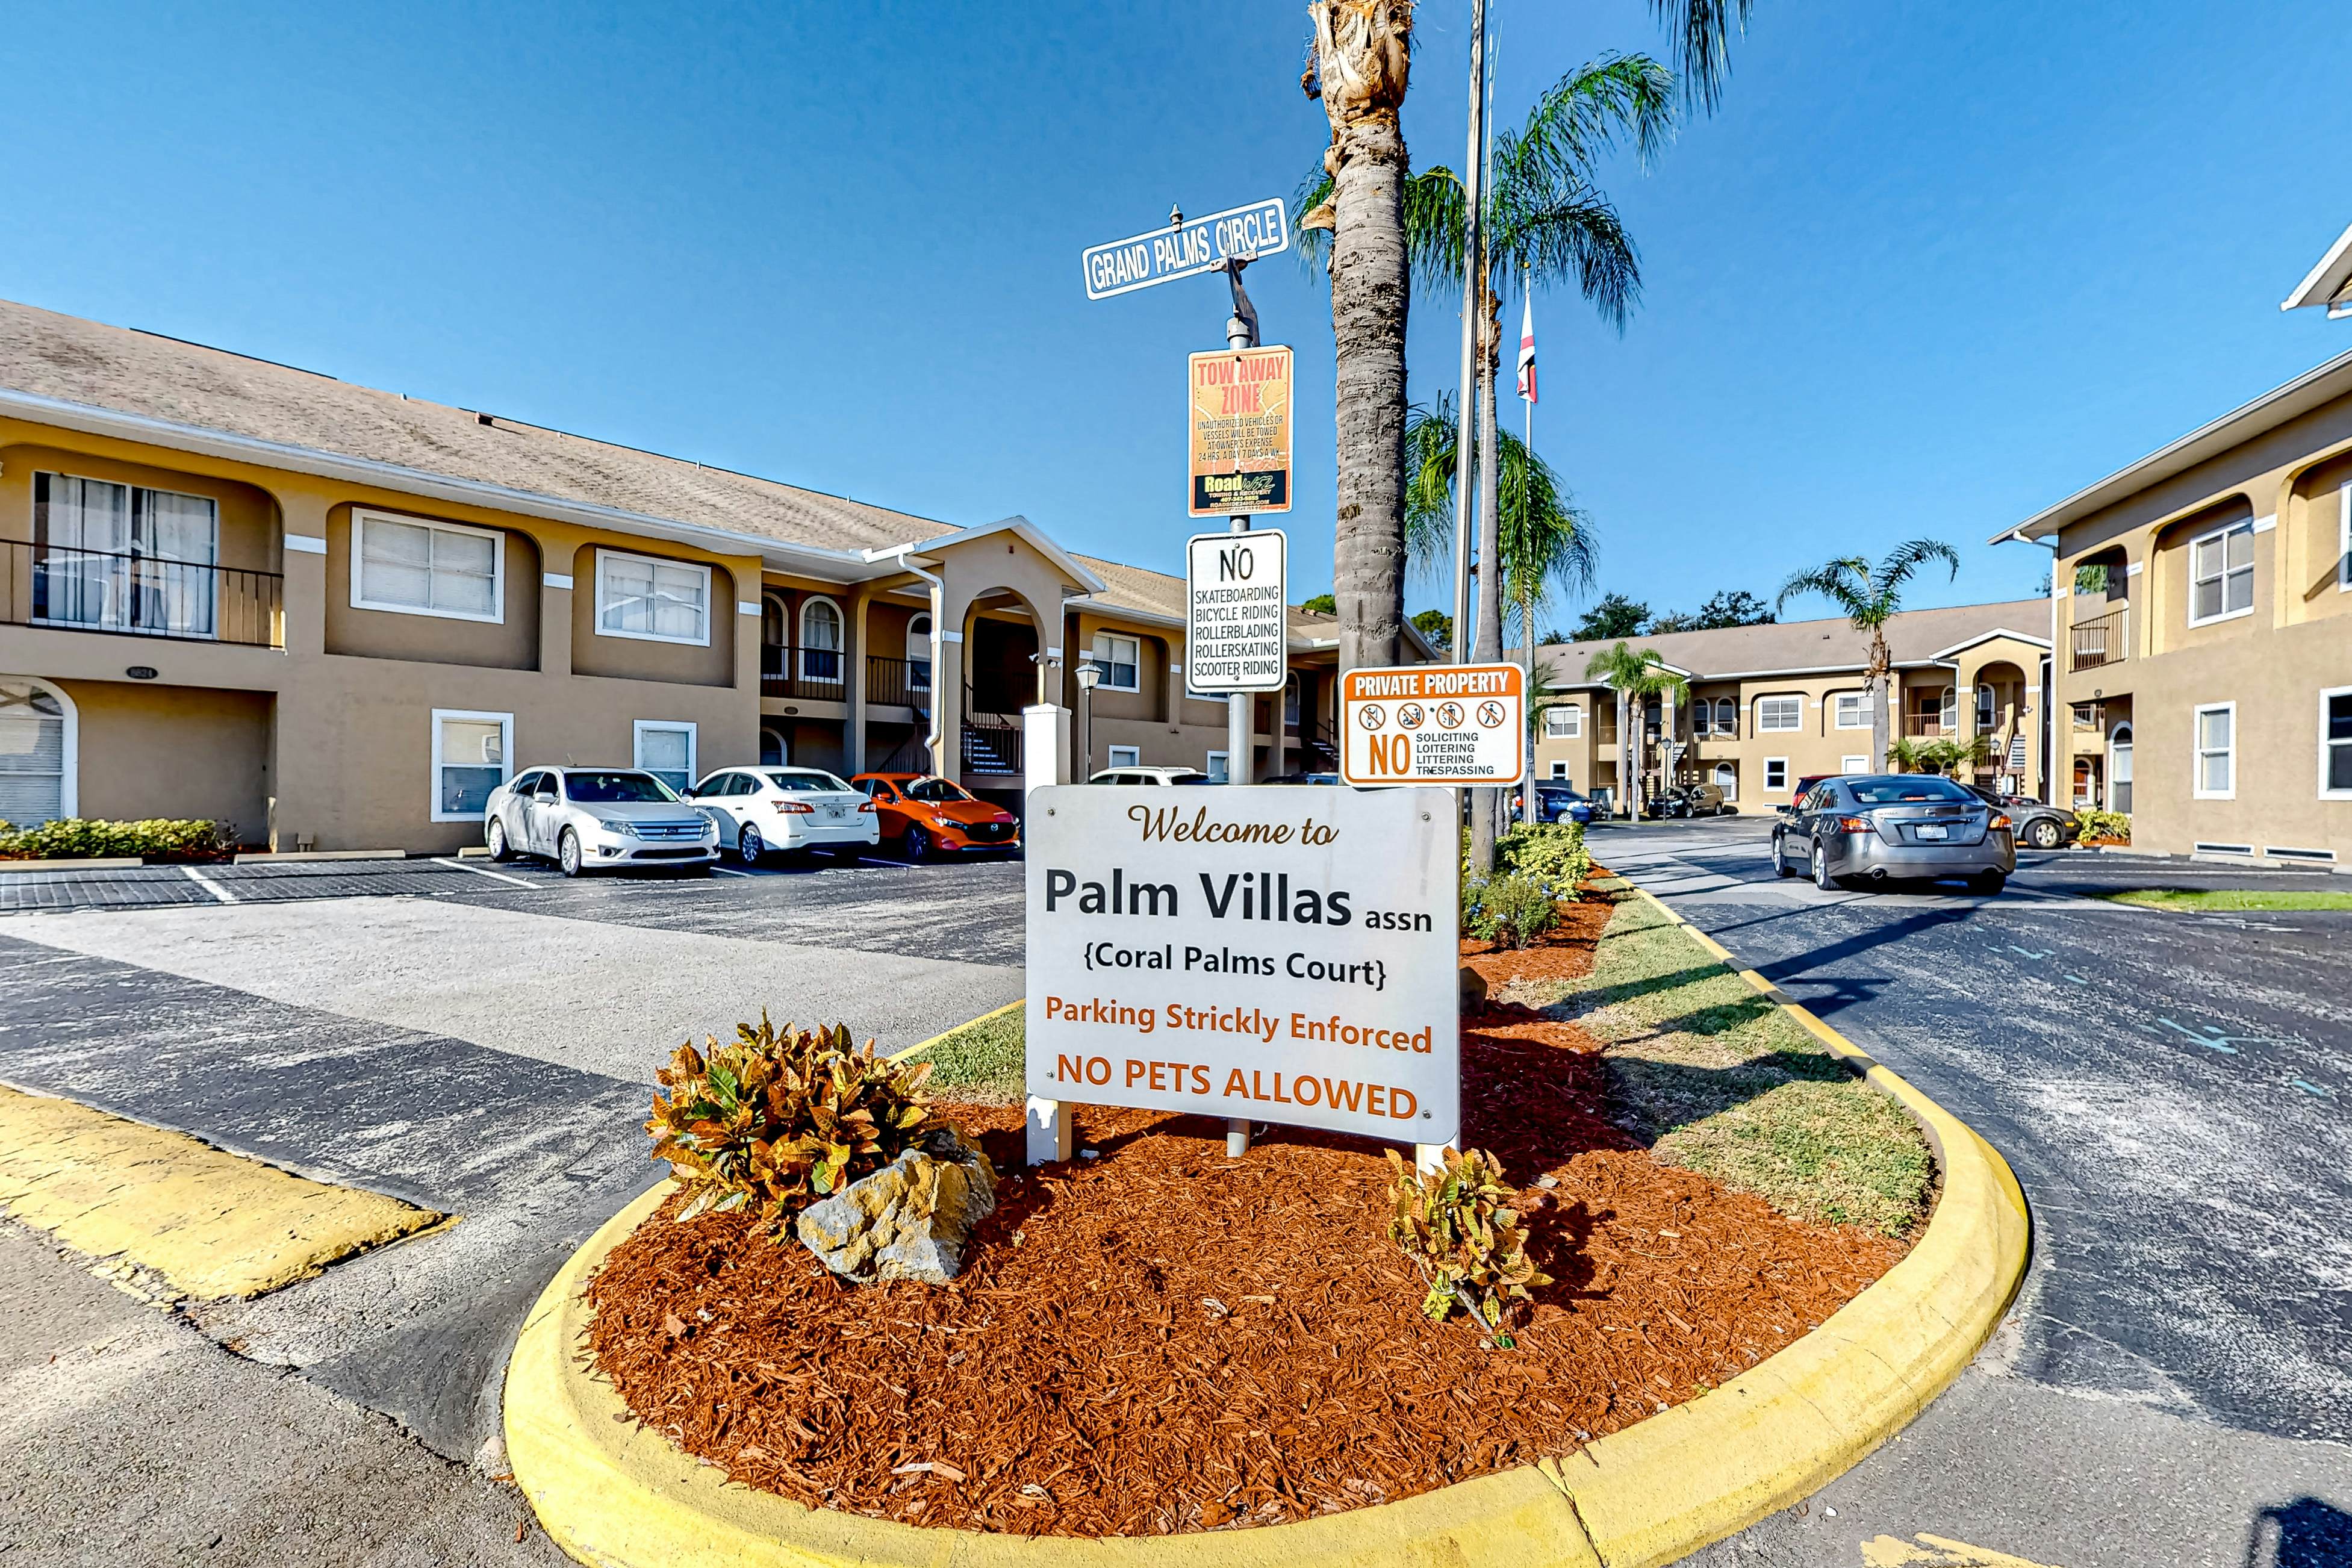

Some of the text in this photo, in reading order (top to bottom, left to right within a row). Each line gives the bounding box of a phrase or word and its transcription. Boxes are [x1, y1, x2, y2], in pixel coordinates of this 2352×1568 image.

[1090, 208, 1280, 291] GRAND PALMS CIRCLE
[1198, 356, 1284, 385] TOW AWAY
[1222, 384, 1260, 414] ZONE
[1198, 415, 1283, 430] UNAUTHORIZED VEHICLES OR
[1204, 426, 1277, 440] VESSELS WILL BE TOWED
[1207, 437, 1273, 450] AT OWNER'S EXPENSE
[1198, 453, 1206, 461] 24
[1223, 451, 1227, 459] A
[1228, 450, 1241, 459] DAY
[1242, 450, 1246, 458] 7
[1248, 449, 1263, 458] DAYS
[1265, 448, 1269, 457] A
[1220, 548, 1254, 582] NO
[1195, 585, 1278, 604] SKATEBOARDING
[1196, 605, 1278, 622] BICYCLE RIDING
[1195, 623, 1278, 640] ROLLERBLADING
[1195, 642, 1278, 658] ROLLERSKATING
[1195, 660, 1278, 676] SCOOTER RIDING
[1355, 671, 1509, 697] PRIVATE PROPERTY
[1416, 732, 1478, 742] SOLICITING
[1369, 734, 1410, 775] NO
[1416, 744, 1475, 753] LOITERING
[1416, 754, 1473, 764] LITTERING
[1416, 765, 1494, 775] TRESPASSING
[1128, 804, 1340, 845] Welcome to
[1045, 867, 1433, 932] Palm Villas assn
[1084, 942, 1387, 992] {Coral Palms Court}
[1045, 996, 1433, 1054] Parking Strickly Enforced
[1057, 1054, 1418, 1121] NO PETS ALLOWED
